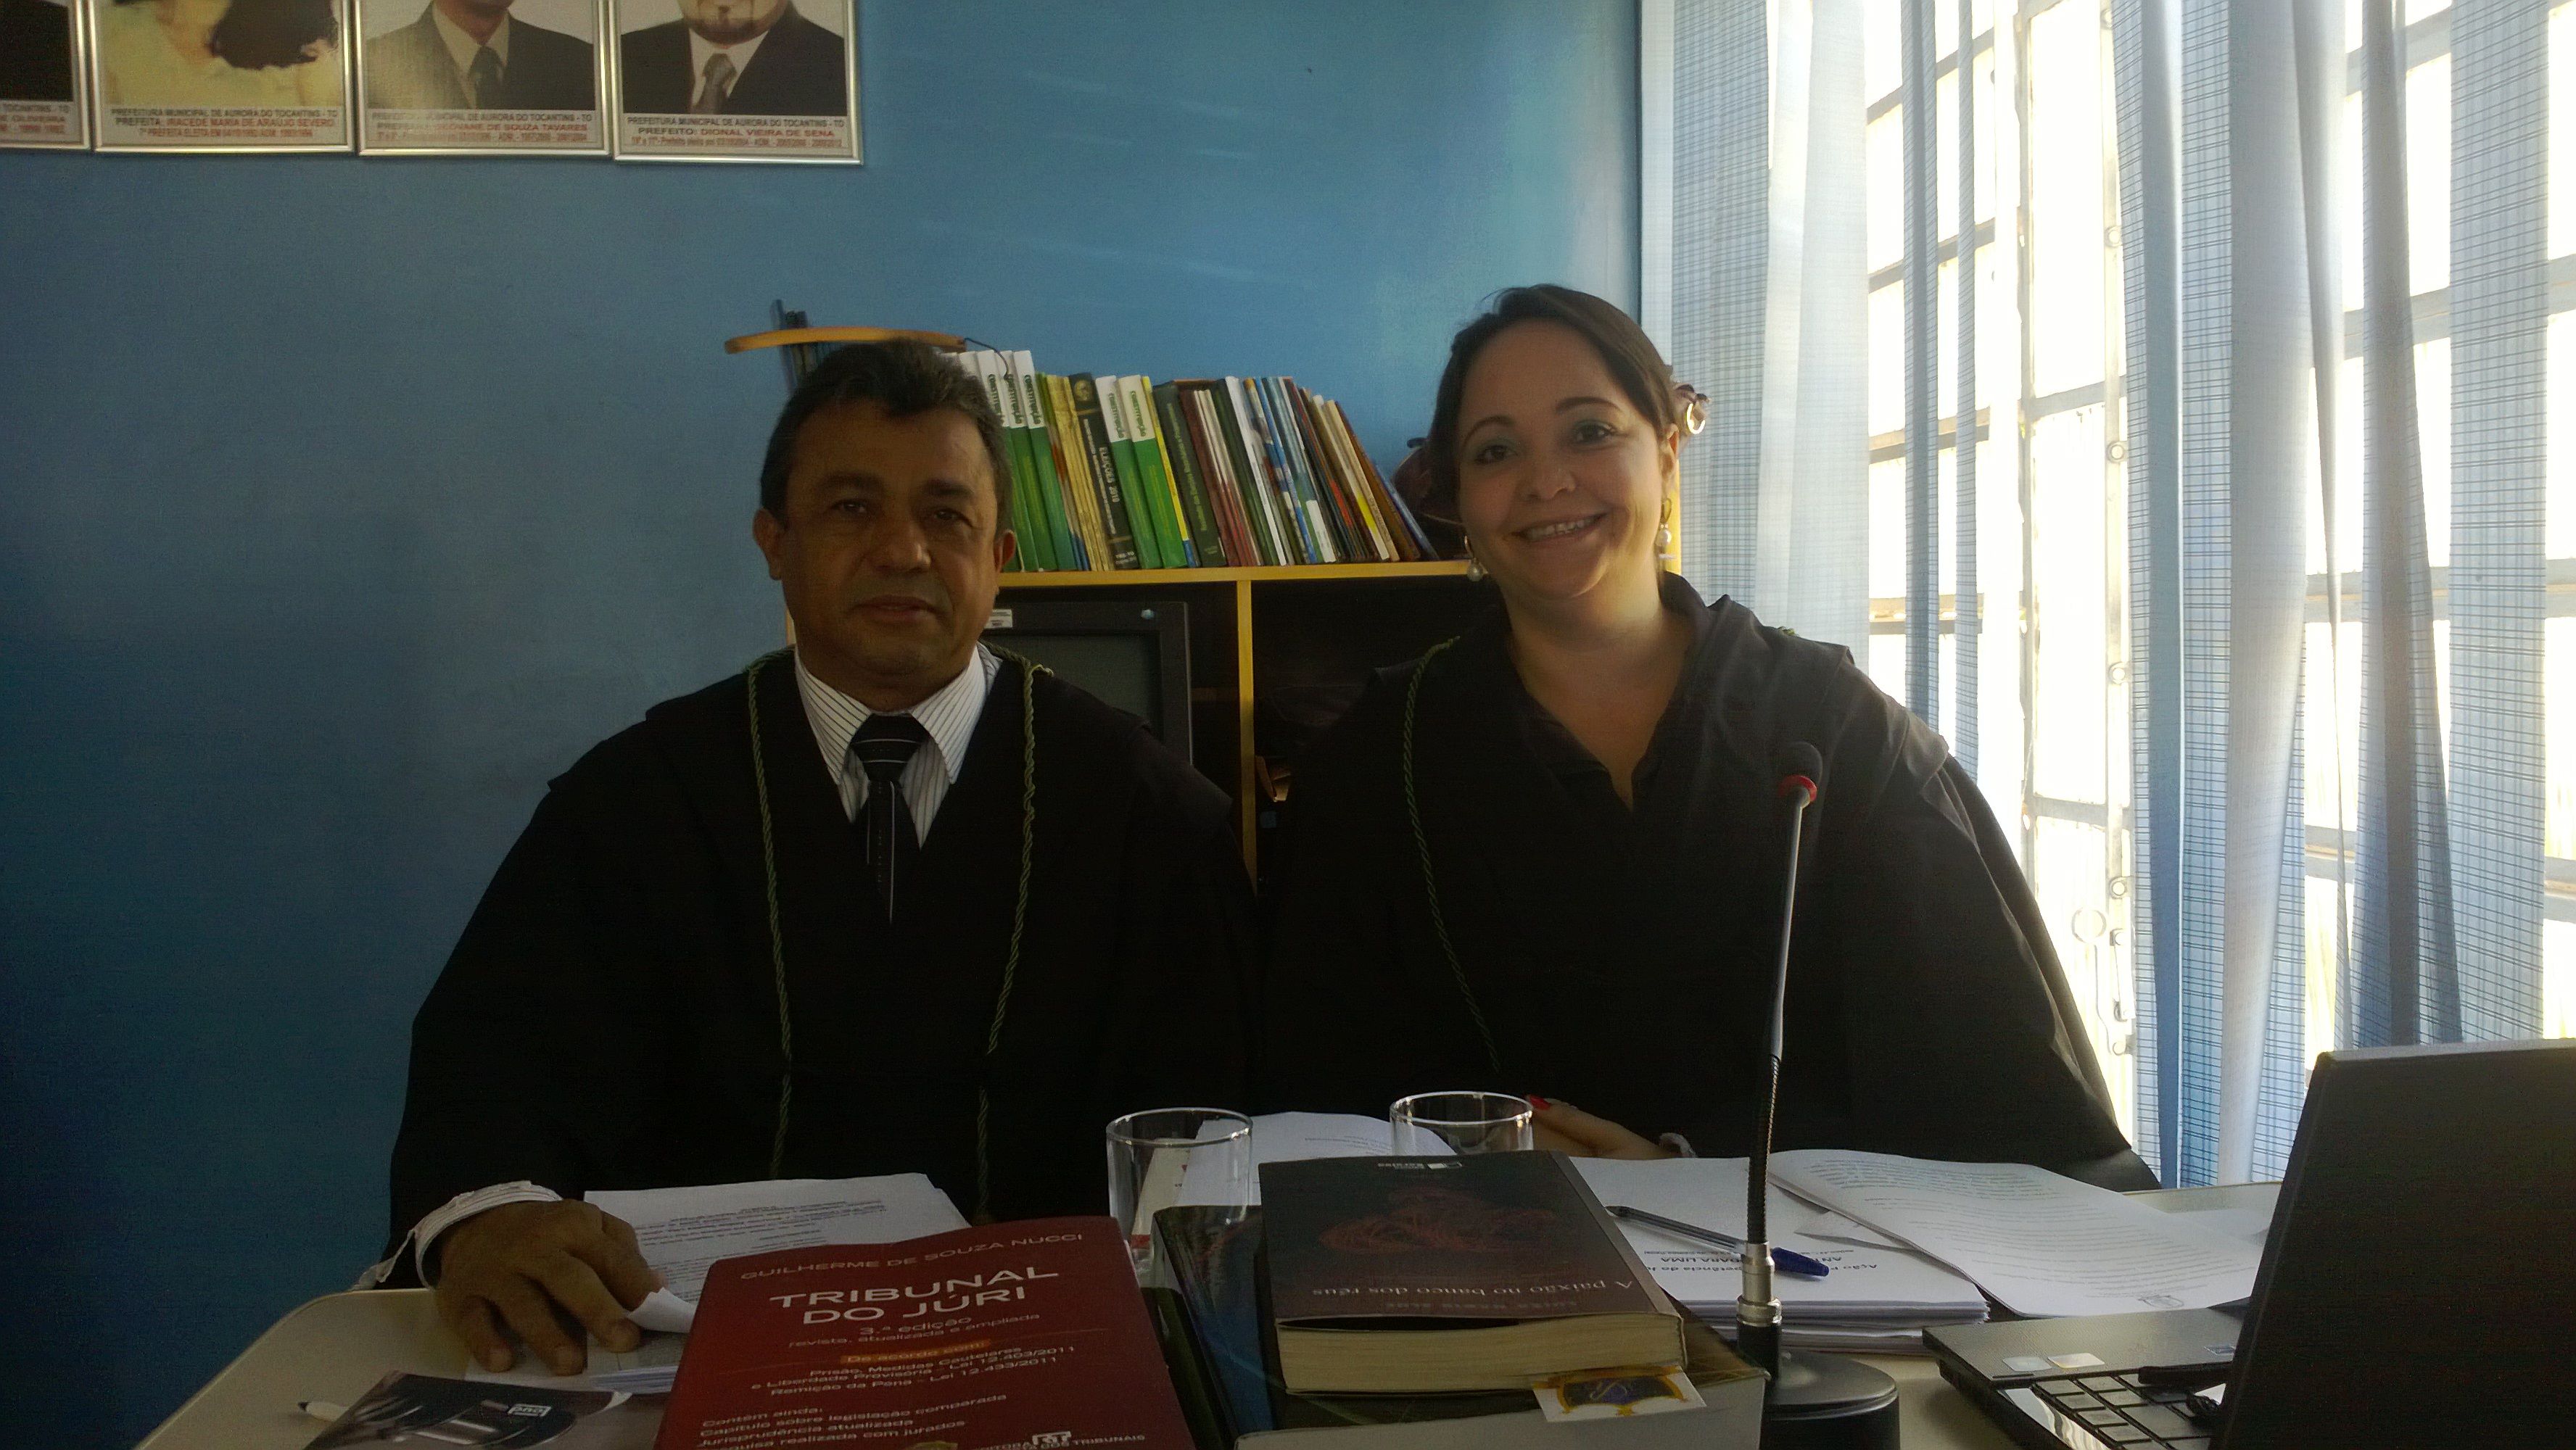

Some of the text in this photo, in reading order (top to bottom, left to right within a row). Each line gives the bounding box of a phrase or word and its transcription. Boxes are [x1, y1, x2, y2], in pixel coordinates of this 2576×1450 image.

[678, 117, 720, 126] MUNICIPAL
[740, 1260, 880, 1280] GUILHERME
[887, 1256, 918, 1267] DE
[924, 1242, 1004, 1262] SOUZA
[1011, 1233, 1083, 1247] NUCCI
[769, 1267, 1060, 1309] TRIBUNAL
[1368, 1287, 1408, 1296] dos
[1416, 1287, 1486, 1296] banco
[1530, 1280, 1606, 1293] paixão
[803, 1285, 1025, 1325] DO JÚRI
[859, 1330, 944, 1342] atualizada
[965, 1314, 1041, 1331] ampliada
[899, 1316, 973, 1333] edição
[868, 1362, 934, 1372] Medidas
[938, 1347, 1022, 1366] Cautelares
[767, 1375, 849, 1388] Liberdade
[949, 1360, 973, 1370] Lei
[770, 1383, 841, 1396] Remição
[872, 1379, 912, 1388] Pena
[930, 1372, 954, 1382] Lei
[700, 1394, 1007, 1438] Capítulo sobre legislação comparada
[703, 1413, 768, 1428] Contém
[827, 1419, 914, 1432] atualizada
[780, 1433, 857, 1446] realizada
[863, 1430, 899, 1439] com
[904, 1420, 966, 1438] jurados
[1072, 1434, 1146, 1446] TRIBUNAIS
